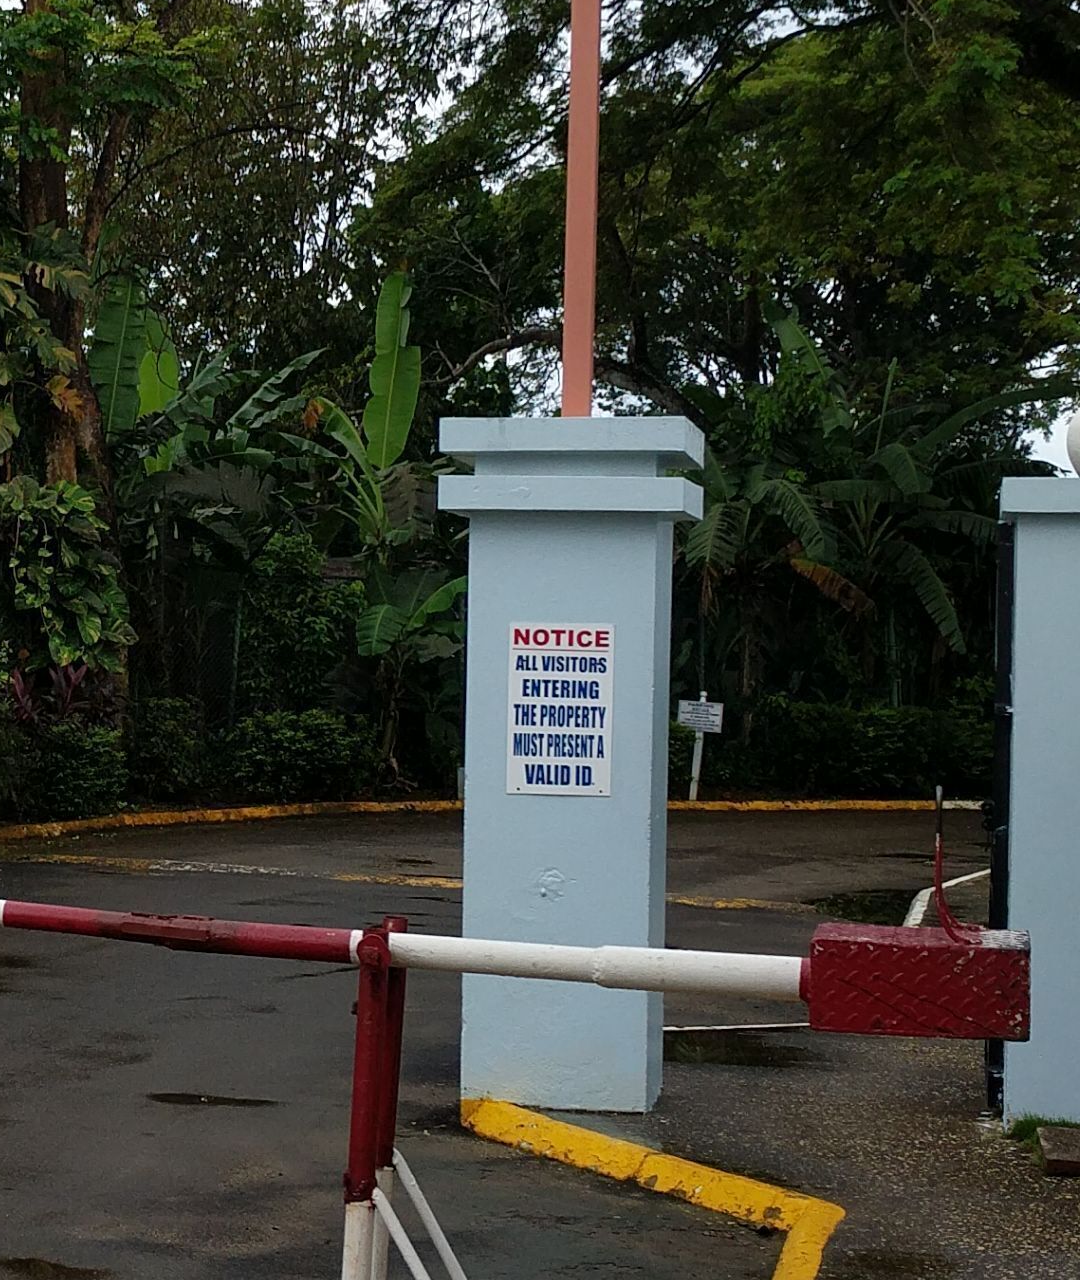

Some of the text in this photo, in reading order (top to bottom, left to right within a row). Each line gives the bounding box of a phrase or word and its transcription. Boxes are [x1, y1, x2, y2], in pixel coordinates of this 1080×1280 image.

[514, 629, 609, 648] NOTICE
[516, 655, 607, 673] ALL VISITORS
[522, 679, 599, 699] ENTERING
[513, 704, 606, 729] THE PROPERTY
[513, 733, 604, 758] MUST PRESENT A
[525, 764, 569, 785] VALID
